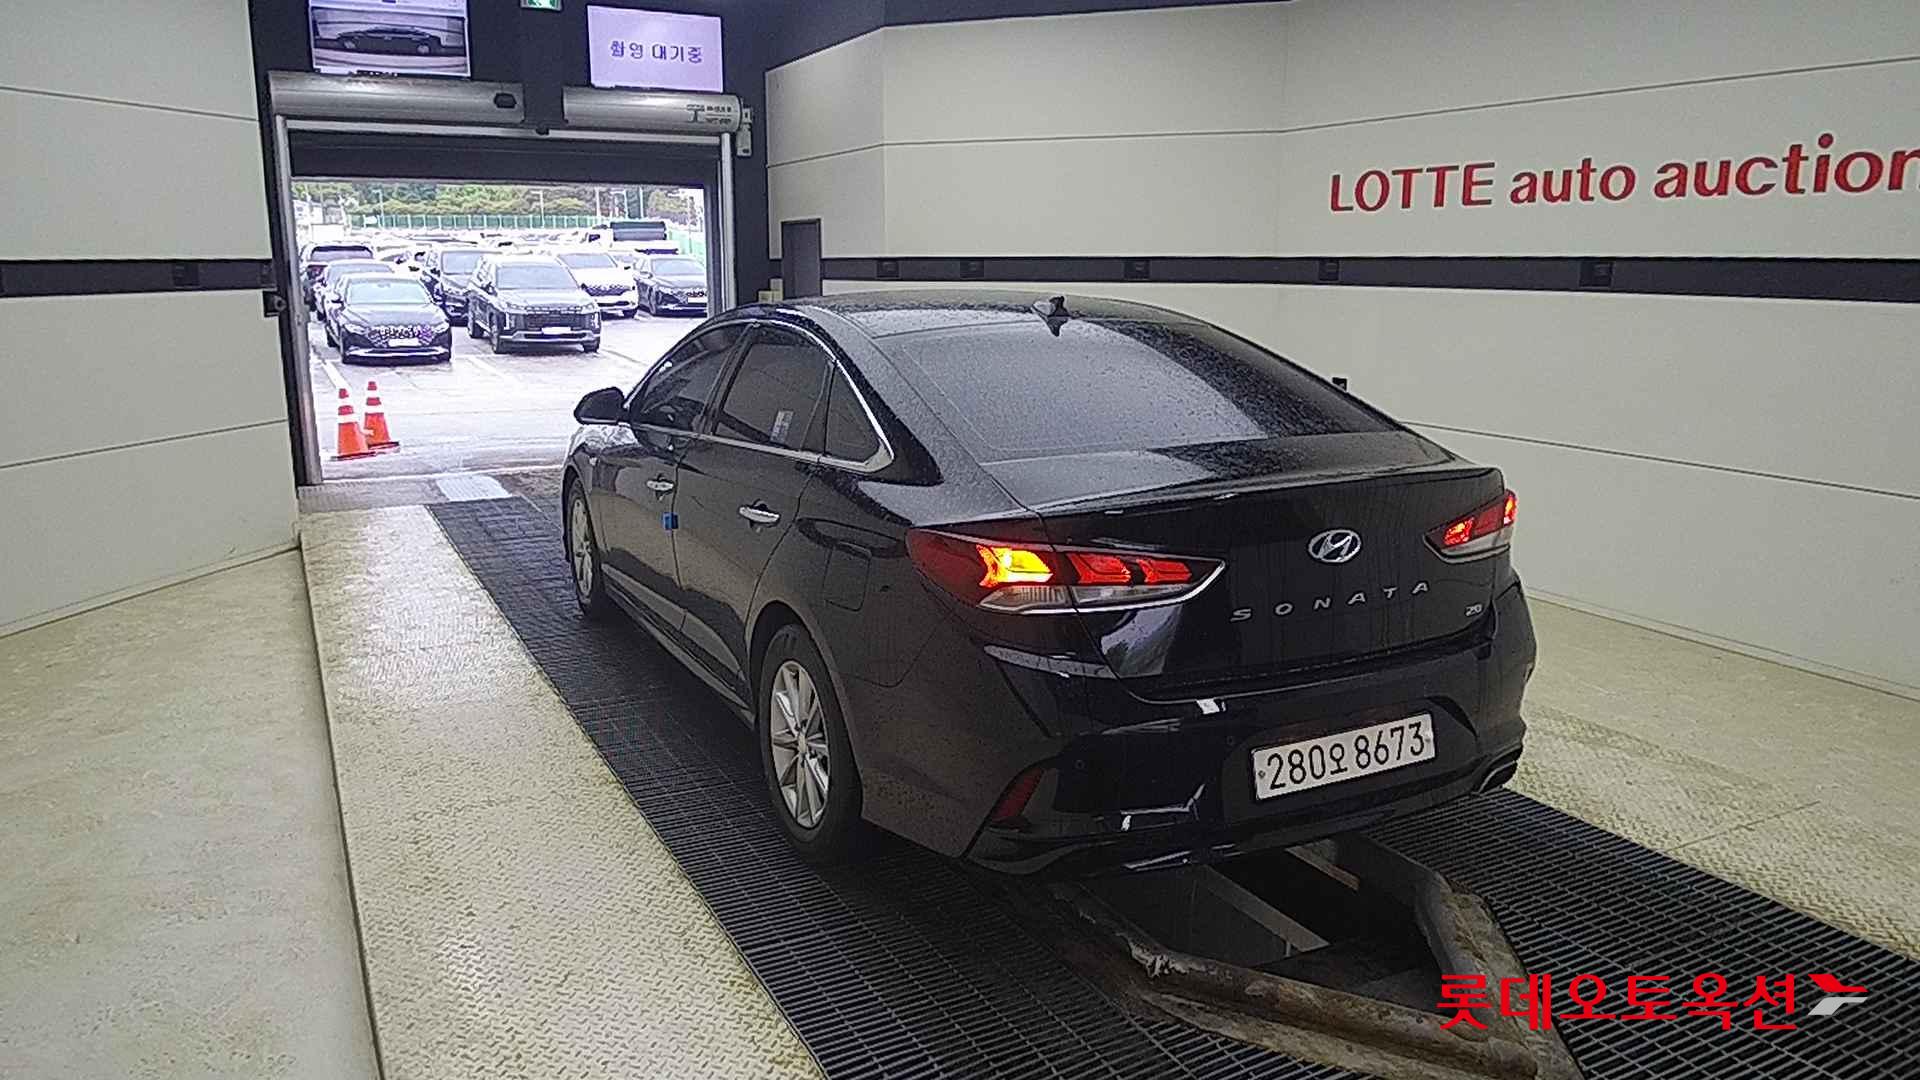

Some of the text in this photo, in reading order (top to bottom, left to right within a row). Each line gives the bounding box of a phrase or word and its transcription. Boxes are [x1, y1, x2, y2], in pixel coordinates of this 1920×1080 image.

[611, 41, 702, 63] 촬영 대기중
[1330, 162, 1495, 212] LOTTE
[1509, 158, 1636, 204] auto
[1230, 582, 1429, 622] SONATA
[1267, 721, 1424, 790] 280오 8673
